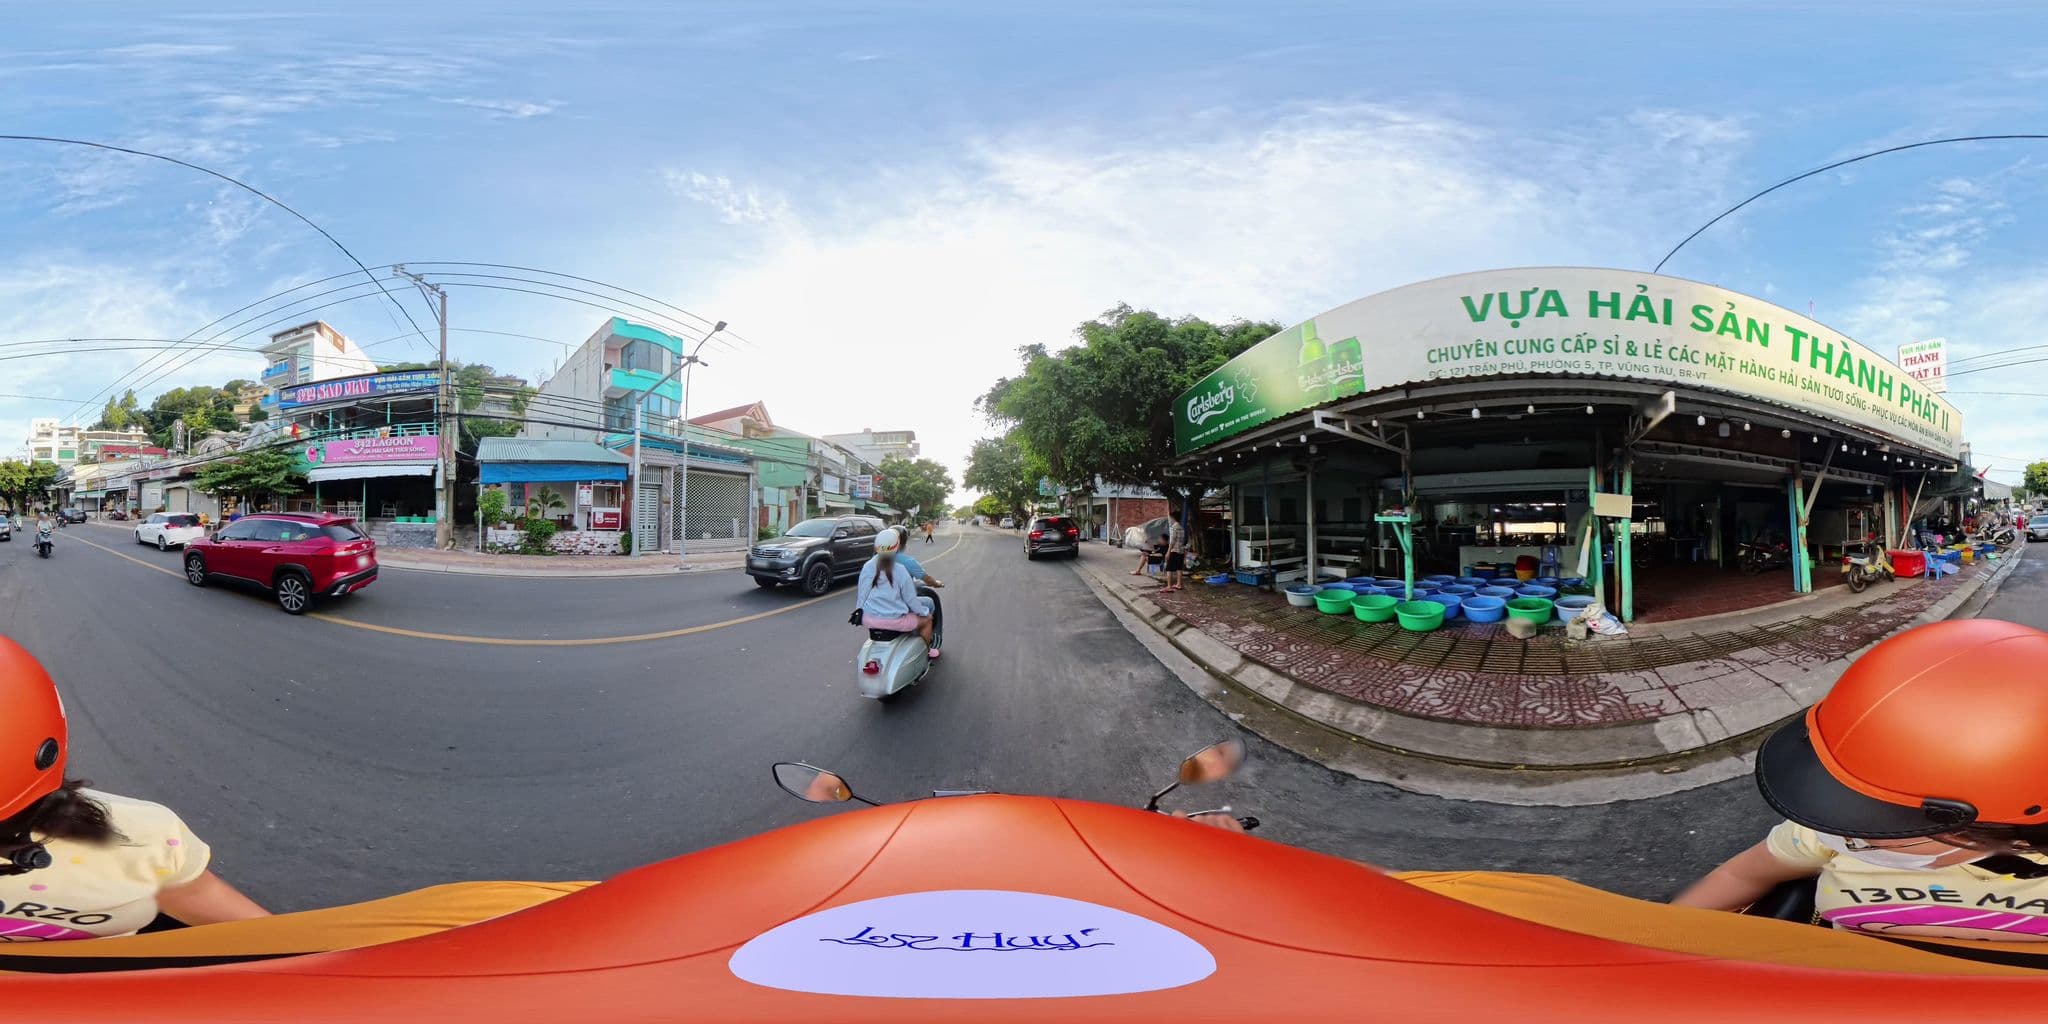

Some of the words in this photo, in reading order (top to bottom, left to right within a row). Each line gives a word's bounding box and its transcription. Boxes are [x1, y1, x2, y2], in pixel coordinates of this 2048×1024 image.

[1427, 339, 1498, 364] CHUYÊN
[1504, 338, 1555, 355] CUNG
[1561, 332, 1597, 353] CẤP
[1603, 334, 1619, 355] SỈ
[1625, 340, 1638, 357] &
[1644, 339, 1662, 359] LẺ
[1668, 344, 1700, 364] CÁC
[1705, 351, 1736, 374] MẶT
[1740, 358, 1776, 381] HÀNG
[1779, 368, 1798, 387] HẢI
[1801, 375, 1821, 394] SẢN
[1823, 384, 1843, 402] TƯƠI
[1845, 392, 1867, 411] SỐNG
[1450, 367, 1465, 376] 121
[1585, 361, 1595, 370] 5,
[1599, 361, 1614, 370] TP.
[1680, 369, 1708, 379] BR-VT
[1460, 287, 1569, 328] VỰA
[1588, 284, 1673, 326] HẢI
[1690, 302, 1770, 347] SẢN
[1785, 325, 1893, 402] THÀNH
[1900, 382, 1939, 425] PHÁT
[1187, 385, 1234, 425] Carlsberg
[0, 900, 112, 926] RZO
